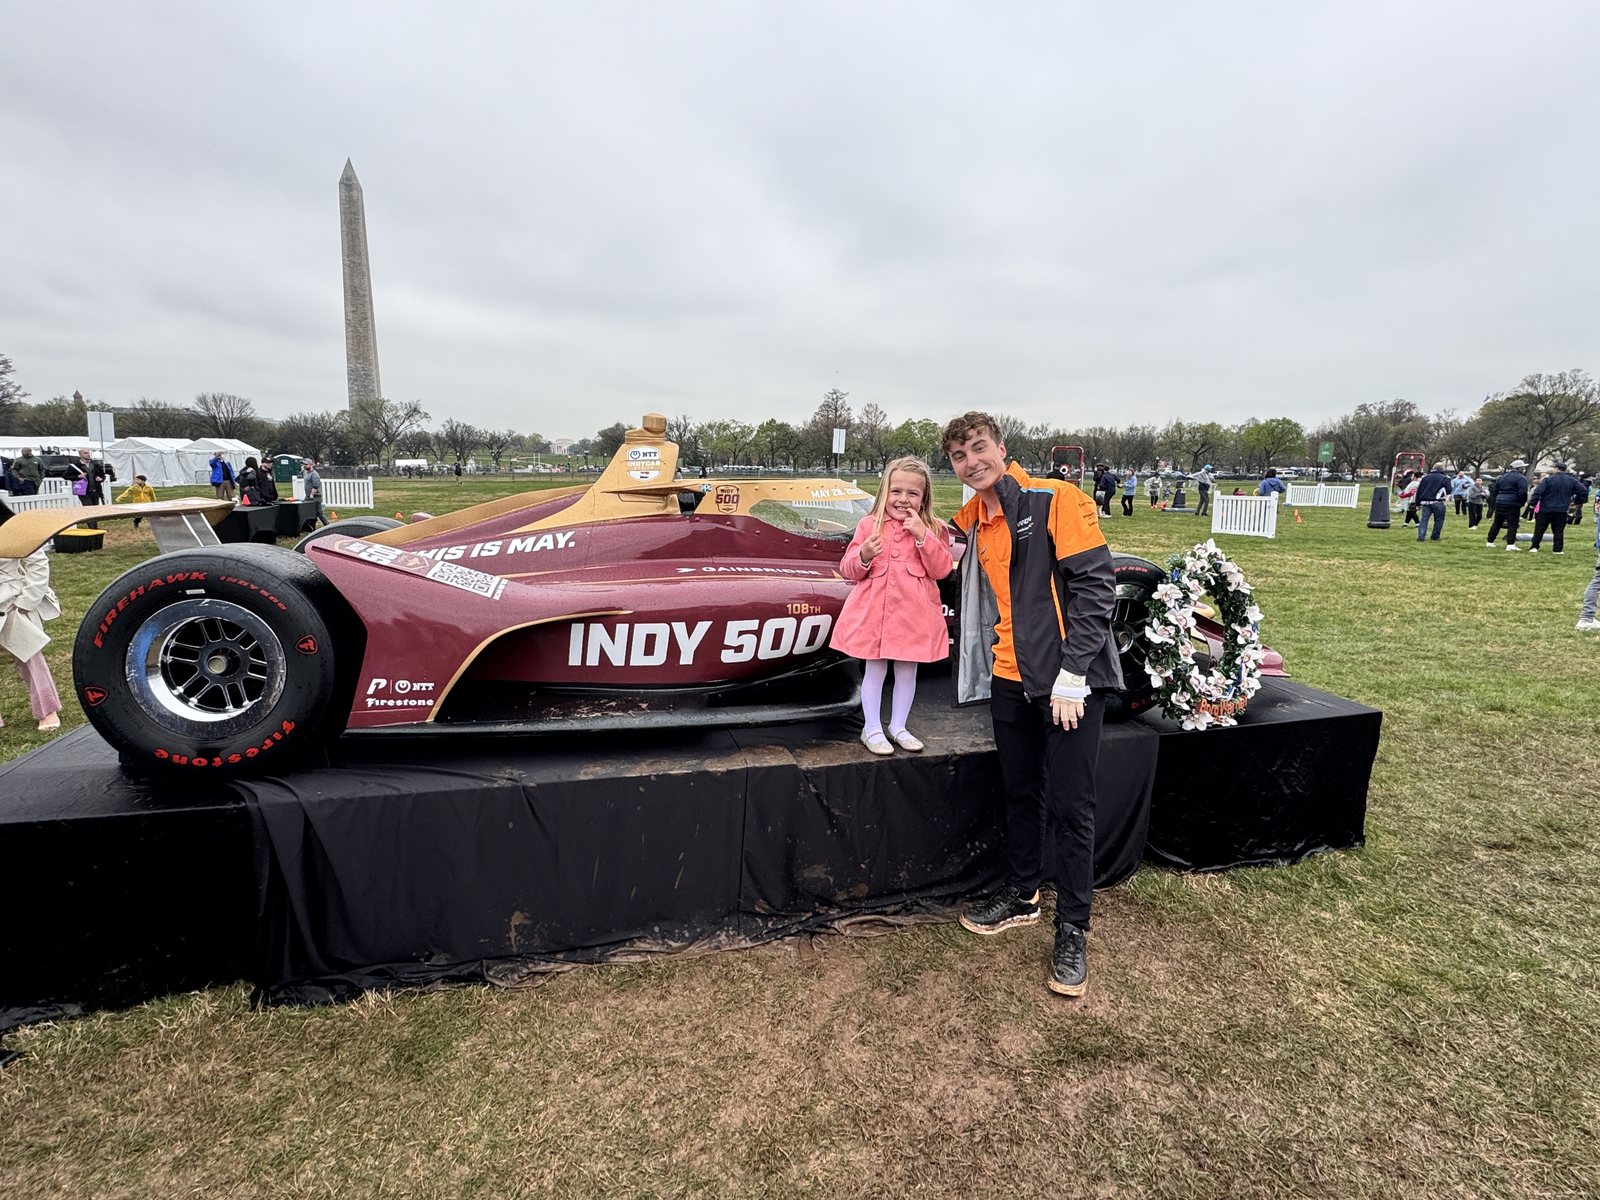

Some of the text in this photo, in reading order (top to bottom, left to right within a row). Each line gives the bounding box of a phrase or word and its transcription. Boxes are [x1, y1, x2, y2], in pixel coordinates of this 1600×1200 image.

[715, 493, 740, 504] 500
[811, 489, 831, 499] MAY
[469, 540, 503, 558] IS
[506, 531, 576, 555] MAY.
[701, 566, 823, 576] GAINBRIDGE
[93, 571, 208, 649] FIREHAWK
[786, 603, 821, 615] 108TH
[567, 614, 833, 667] INDY 500
[412, 682, 435, 691] NTT
[365, 697, 435, 708] Firestone
[153, 719, 296, 767] Firestone
